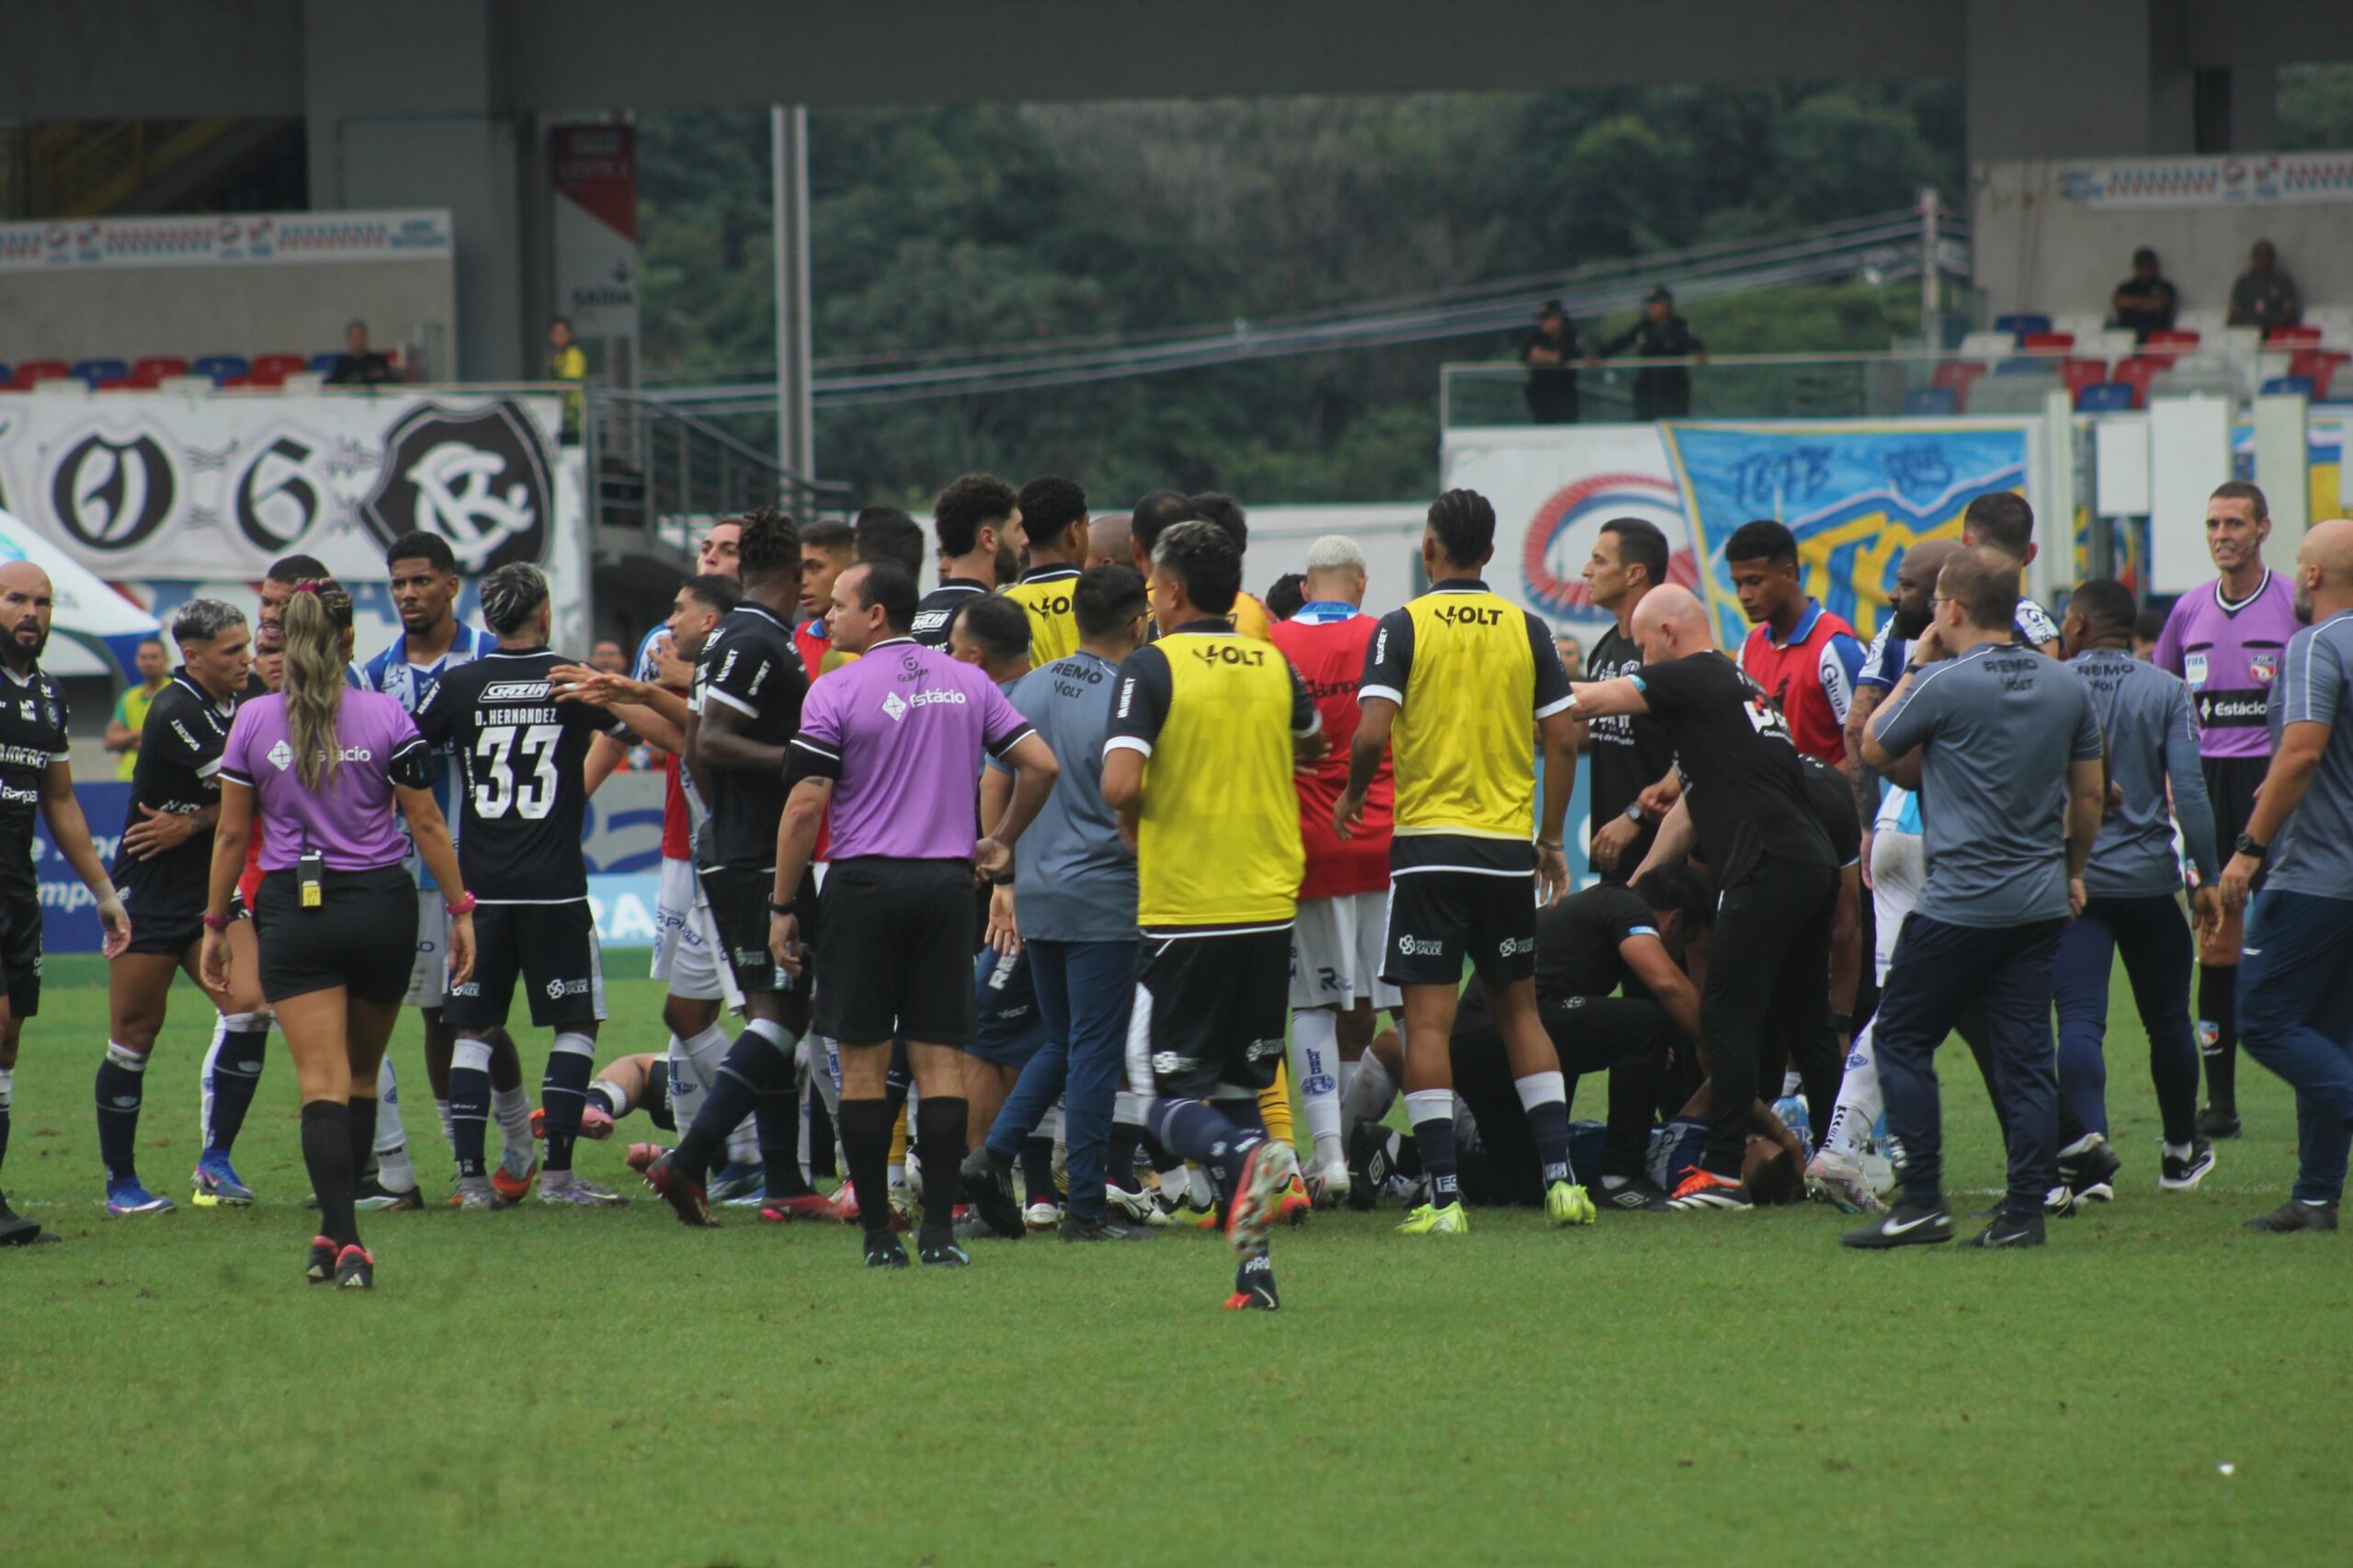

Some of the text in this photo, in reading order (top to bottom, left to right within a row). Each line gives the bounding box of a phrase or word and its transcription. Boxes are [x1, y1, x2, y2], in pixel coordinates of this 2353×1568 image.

[1434, 606, 1503, 628] VOLT
[1192, 644, 1265, 668] VOLT
[1051, 662, 1103, 685] REMO
[1983, 659, 2039, 673] REMO
[2077, 664, 2135, 676] REMO
[483, 682, 551, 699] GAZIN
[909, 687, 966, 708] Estácio
[1054, 680, 1083, 699] VOLT
[475, 708, 557, 726] D. HERNANDEZ
[2215, 700, 2268, 716] Estácio
[474, 724, 564, 819] 33
